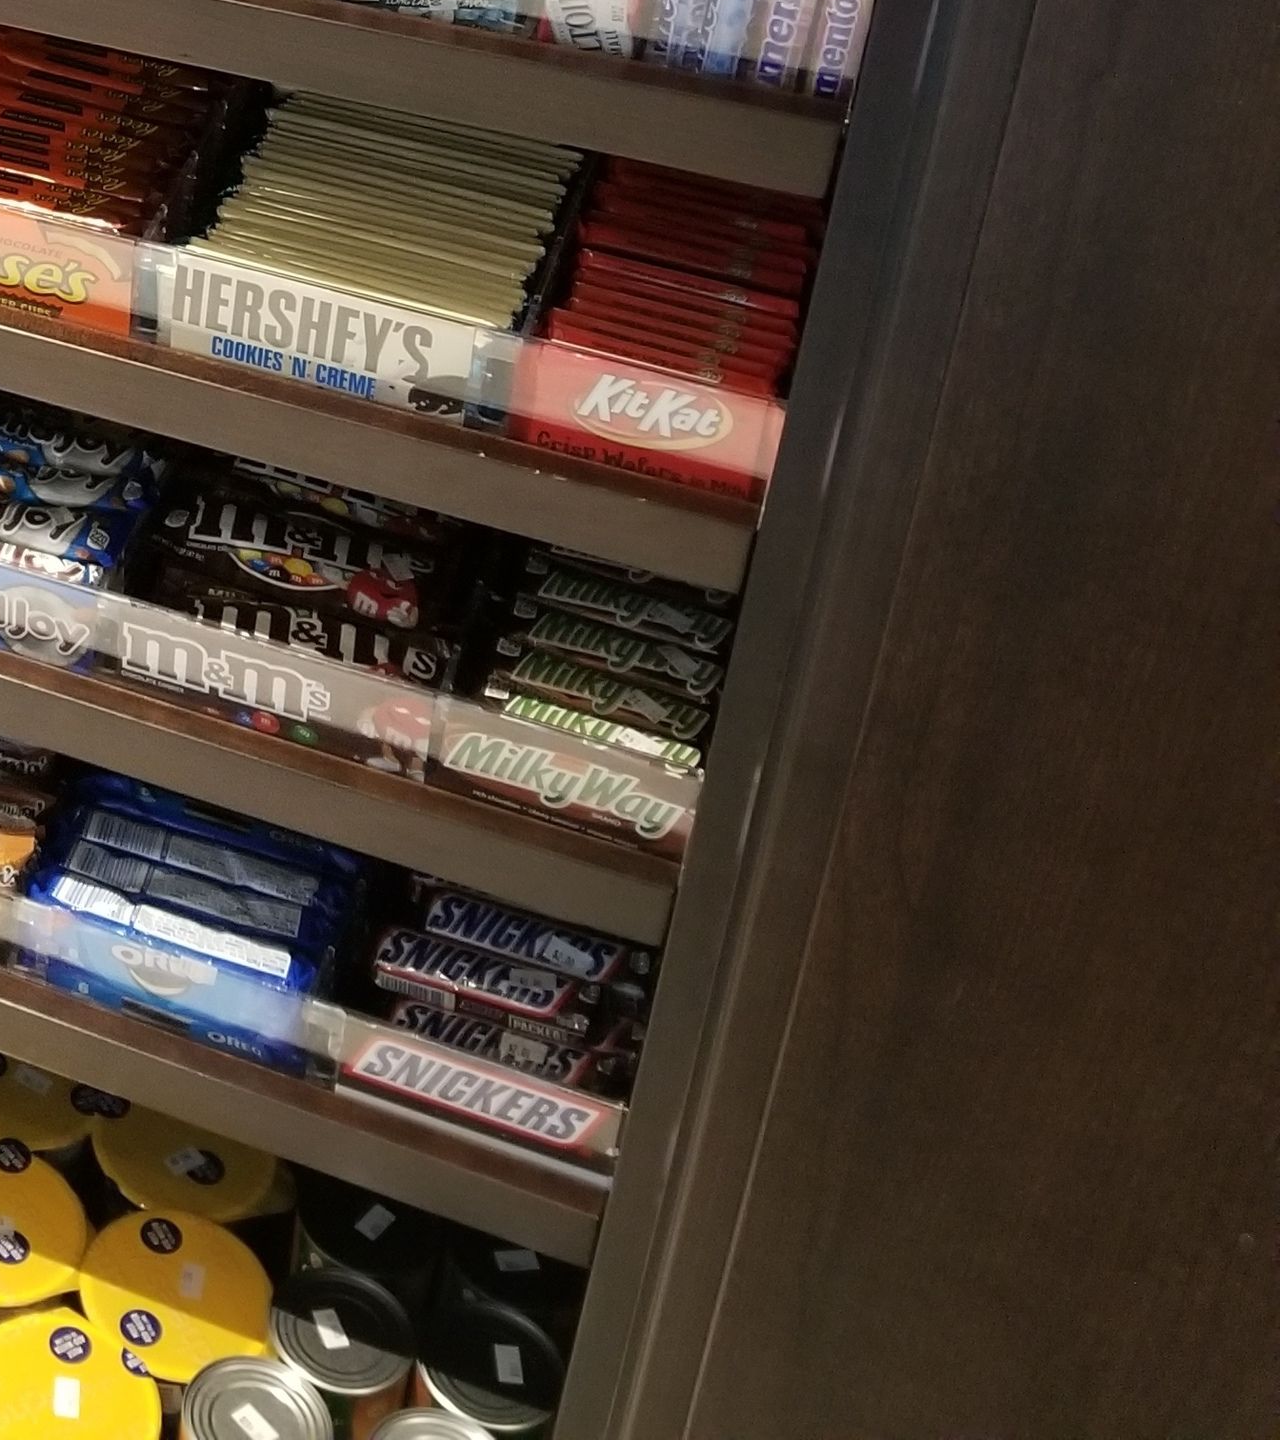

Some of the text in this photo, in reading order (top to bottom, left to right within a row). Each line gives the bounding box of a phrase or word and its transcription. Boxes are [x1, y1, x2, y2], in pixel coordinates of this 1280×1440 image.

[172, 264, 433, 382] HERSHEY'S
[211, 336, 284, 371] COOKIES
[315, 362, 377, 400] CREME
[536, 430, 681, 484] Crisp Wafers
[5, 506, 87, 542] Joy
[6, 598, 90, 656] Joy
[444, 732, 580, 809] Milky
[577, 763, 685, 839] Way
[361, 1043, 592, 1140] SNICKERS
